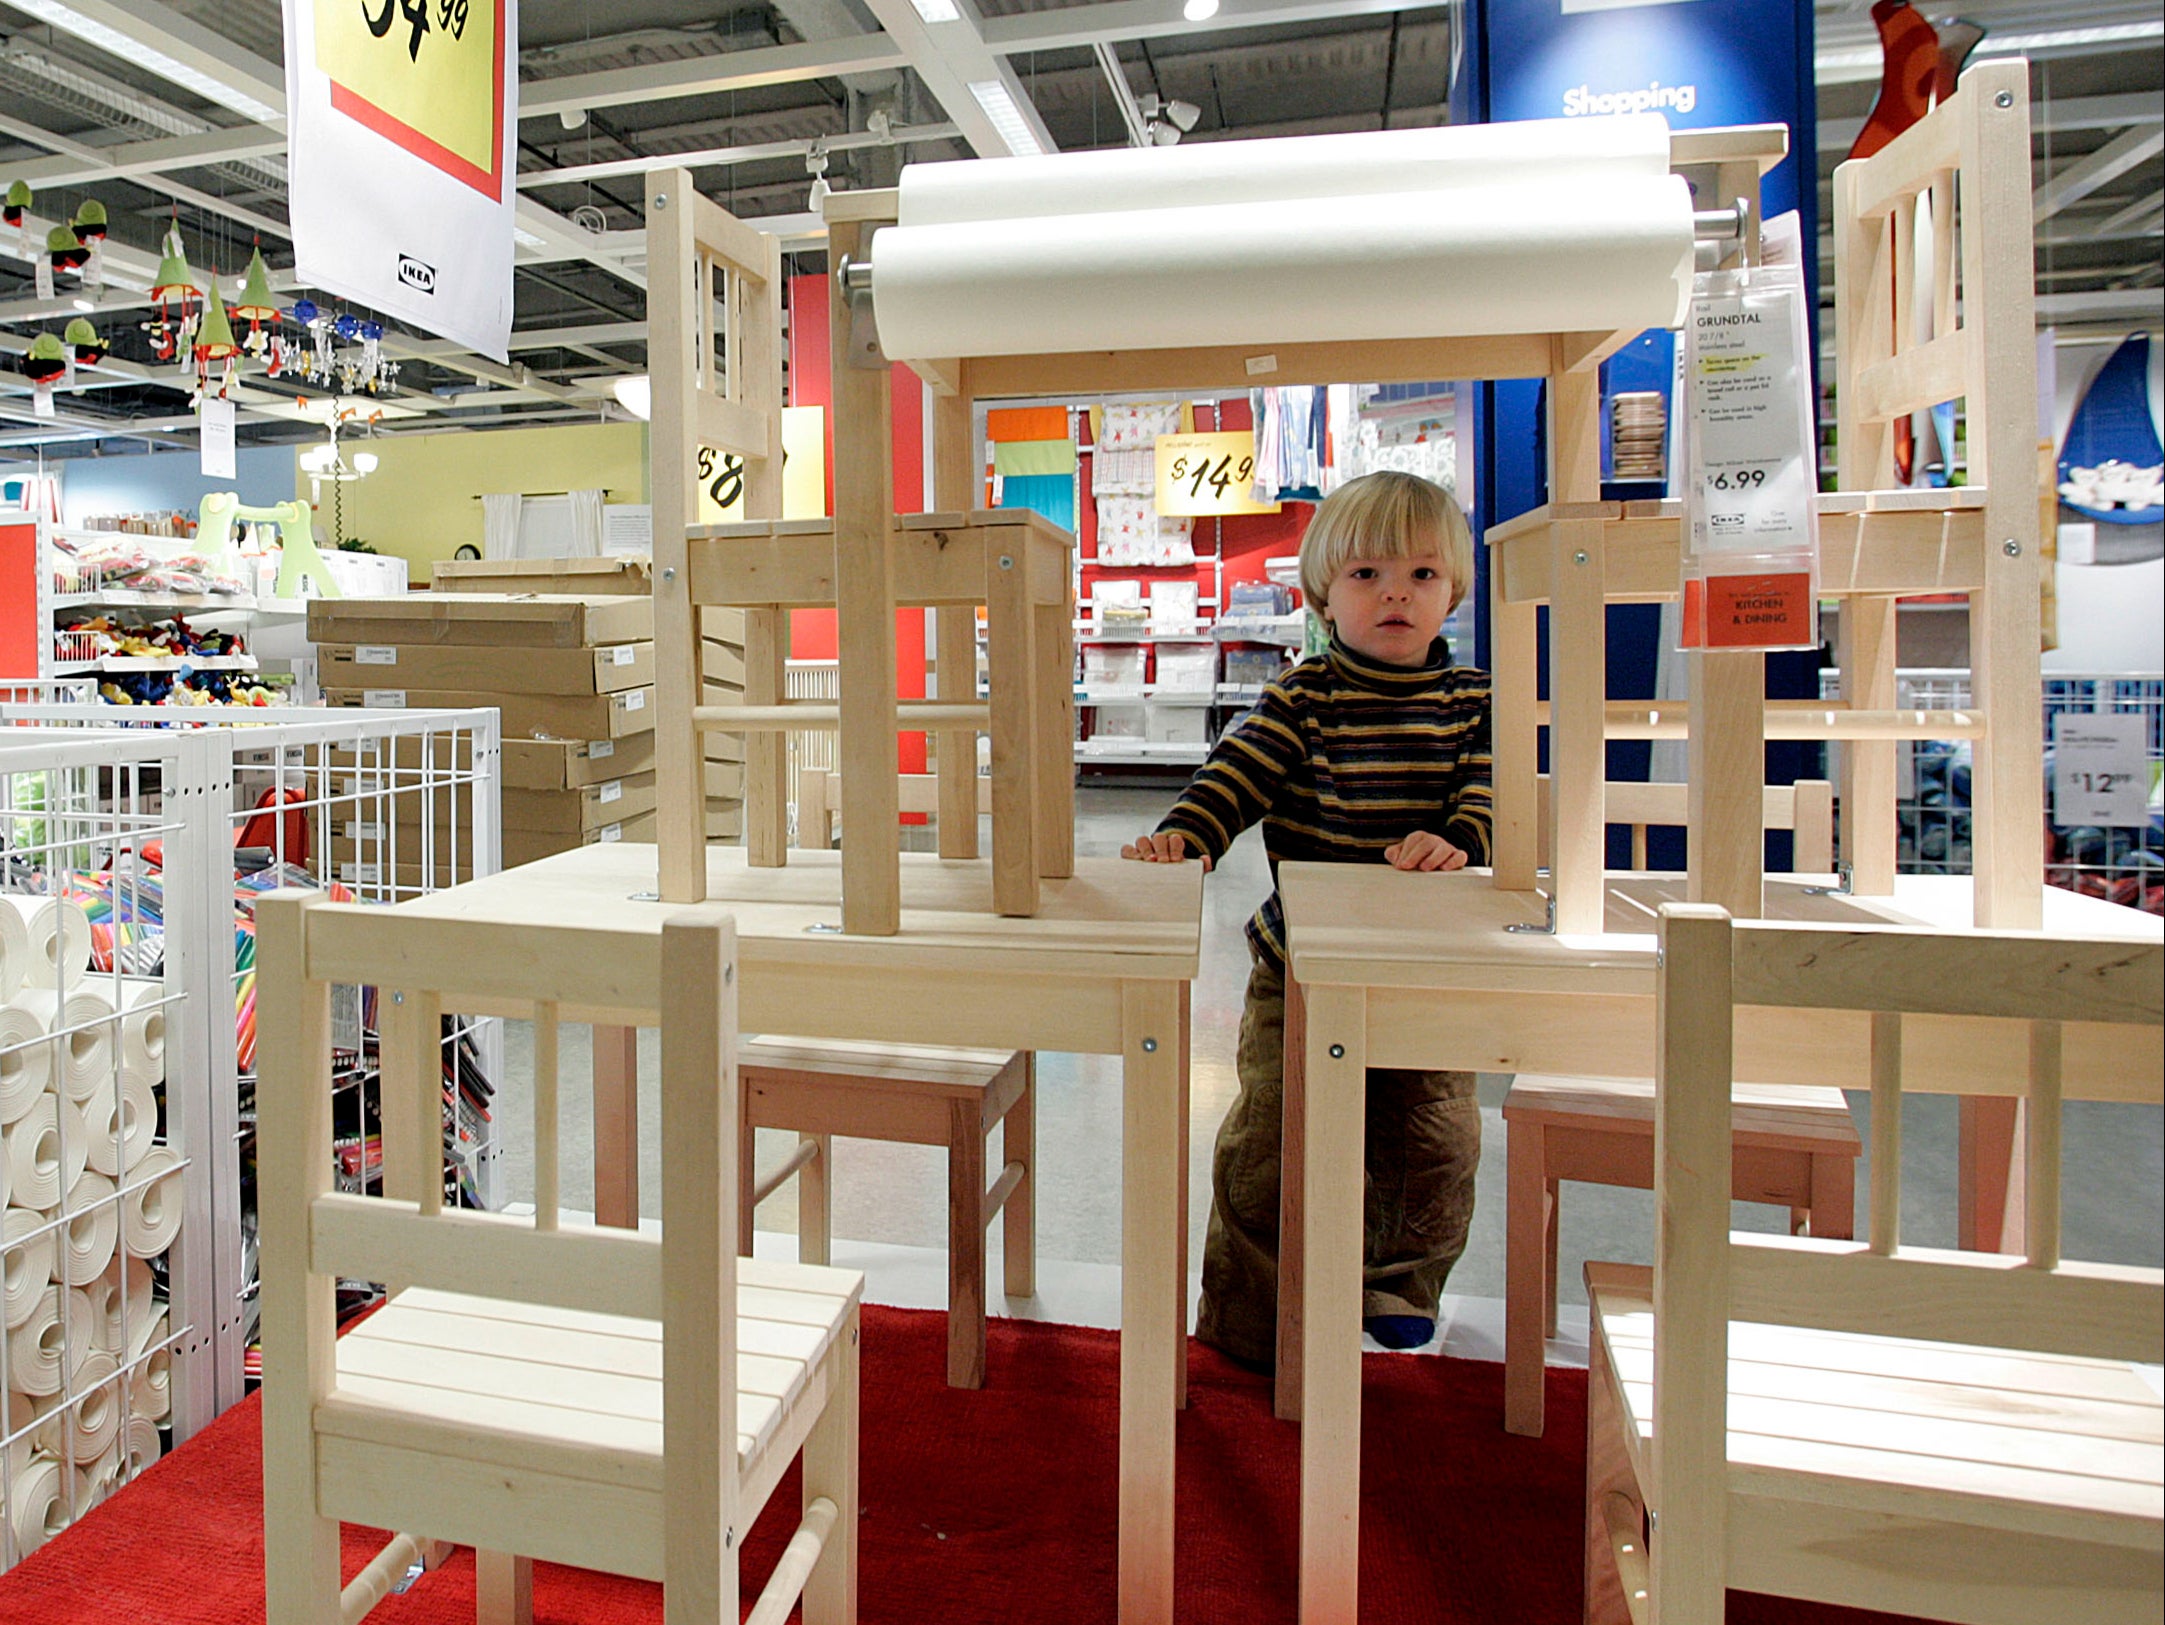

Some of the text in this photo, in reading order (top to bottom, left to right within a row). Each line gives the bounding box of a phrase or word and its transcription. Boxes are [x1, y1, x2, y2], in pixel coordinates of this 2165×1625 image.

[1562, 81, 1696, 116] Shopping
[402, 263, 431, 286] IKEA
[1697, 312, 1762, 327] GRUNDTAL
[1171, 454, 1254, 499] $149
[1706, 470, 1766, 491] $6.99
[1735, 599, 1784, 610] KITCHEN
[1732, 613, 1787, 624] & DINING
